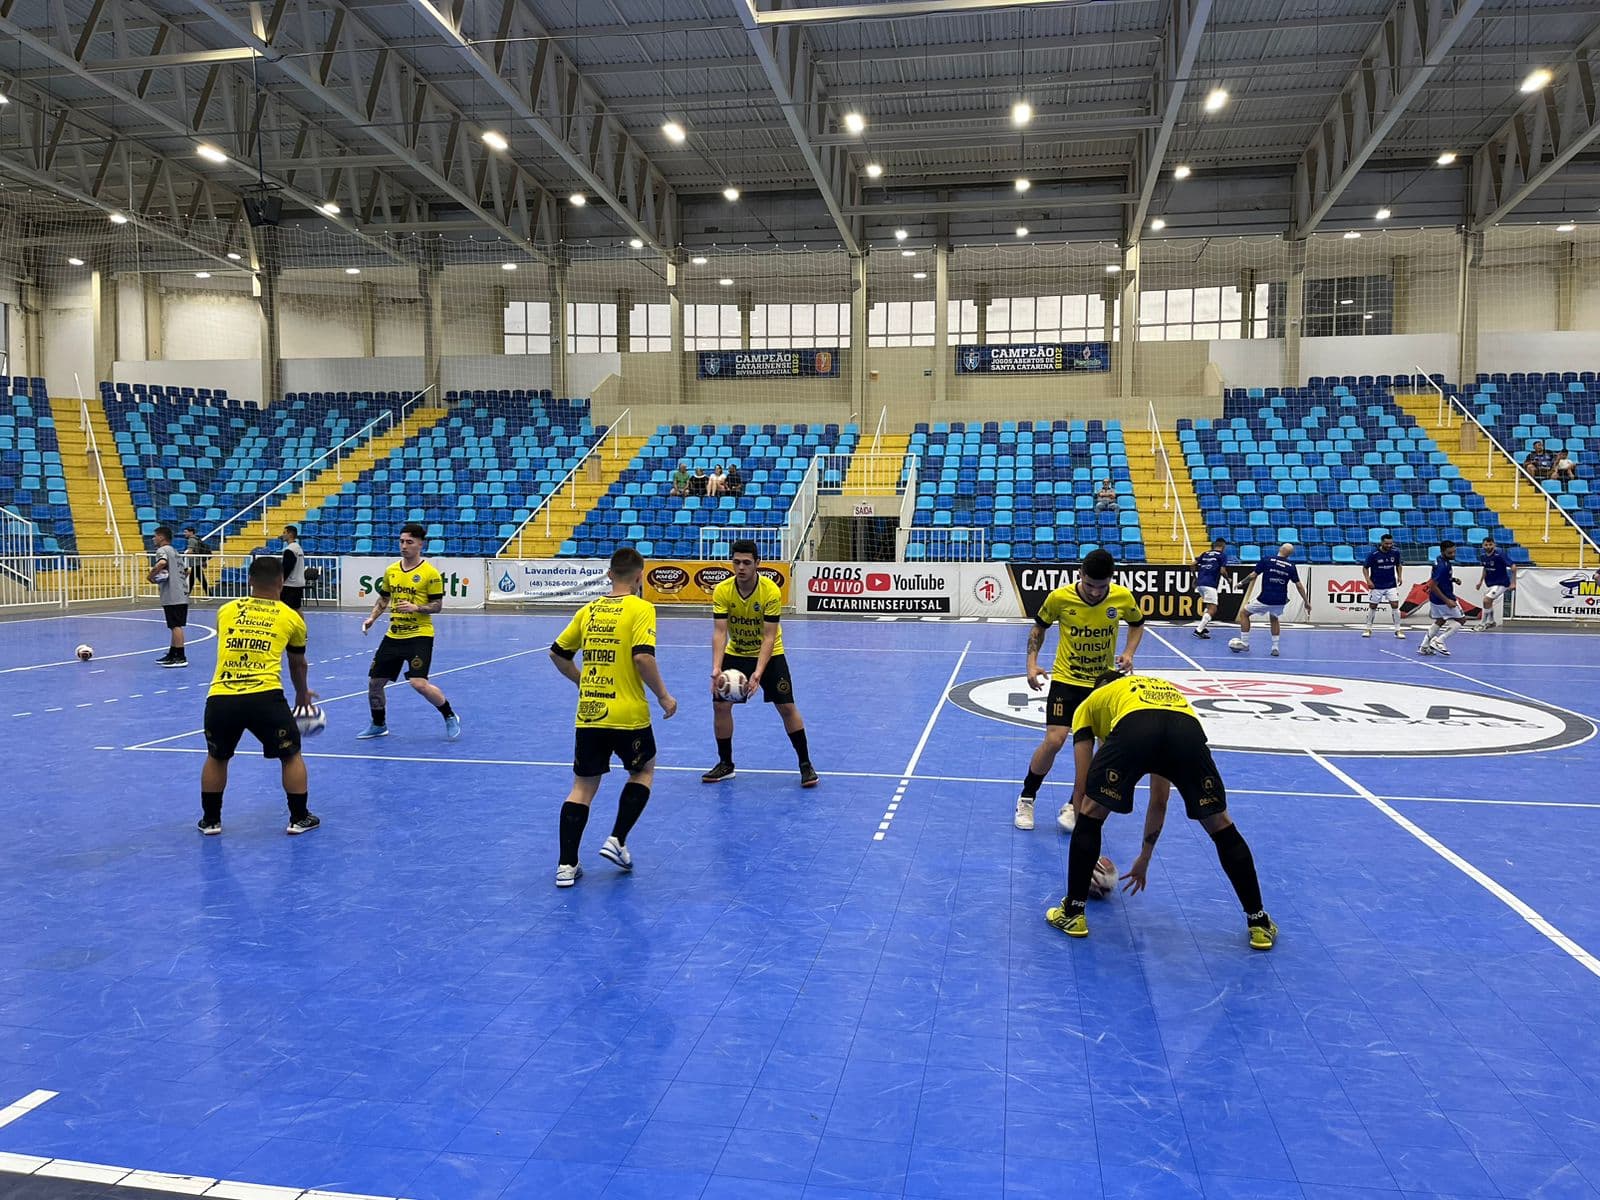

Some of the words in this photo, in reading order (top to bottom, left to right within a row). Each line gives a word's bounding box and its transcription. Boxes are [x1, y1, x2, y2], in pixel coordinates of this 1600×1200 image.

[735, 352, 792, 363] CAMPEÃO
[991, 346, 1055, 358] CAMPEÃO
[1055, 347, 1063, 369] 2018
[735, 362, 792, 370] CATARINENSE
[735, 368, 761, 376] DIVISÃO
[525, 566, 577, 576] Lavanderia
[812, 566, 862, 580] JOGOS
[812, 580, 829, 592] AO
[833, 580, 862, 593] VIVO
[893, 574, 945, 591] YouTube
[817, 598, 942, 611] /CATARINENSEFUTSAL
[235, 618, 273, 628] Articular
[1070, 625, 1115, 638] Orbenk
[584, 690, 616, 699] Unimed
[1053, 703, 1064, 717] 18
